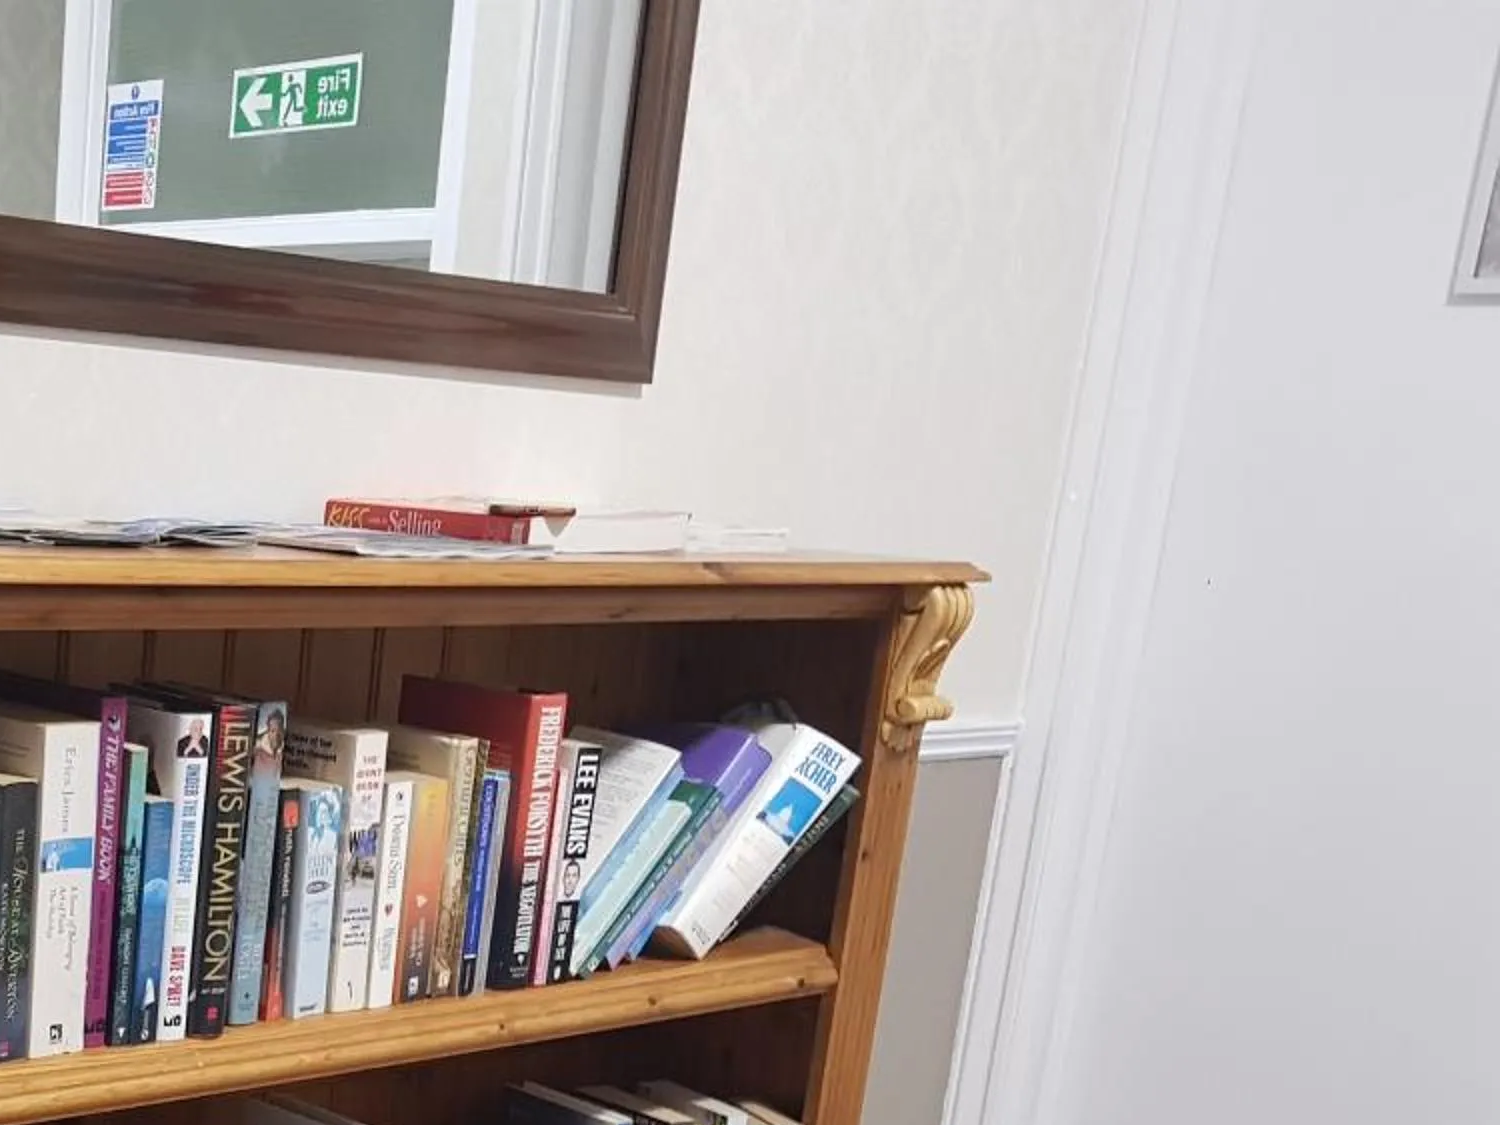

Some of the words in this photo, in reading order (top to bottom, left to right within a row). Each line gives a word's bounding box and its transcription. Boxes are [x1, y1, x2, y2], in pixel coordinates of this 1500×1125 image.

[387, 509, 443, 536] Selling
[105, 734, 121, 770] THE
[218, 720, 250, 813] LEWIS
[532, 706, 562, 789] FREDERICK
[575, 755, 598, 788] LEE
[101, 770, 118, 833] FAMILY
[524, 791, 551, 857] FORSYTH
[566, 793, 592, 856] EVANS
[97, 836, 113, 885] BOOK
[203, 821, 240, 982] HAMILTON
